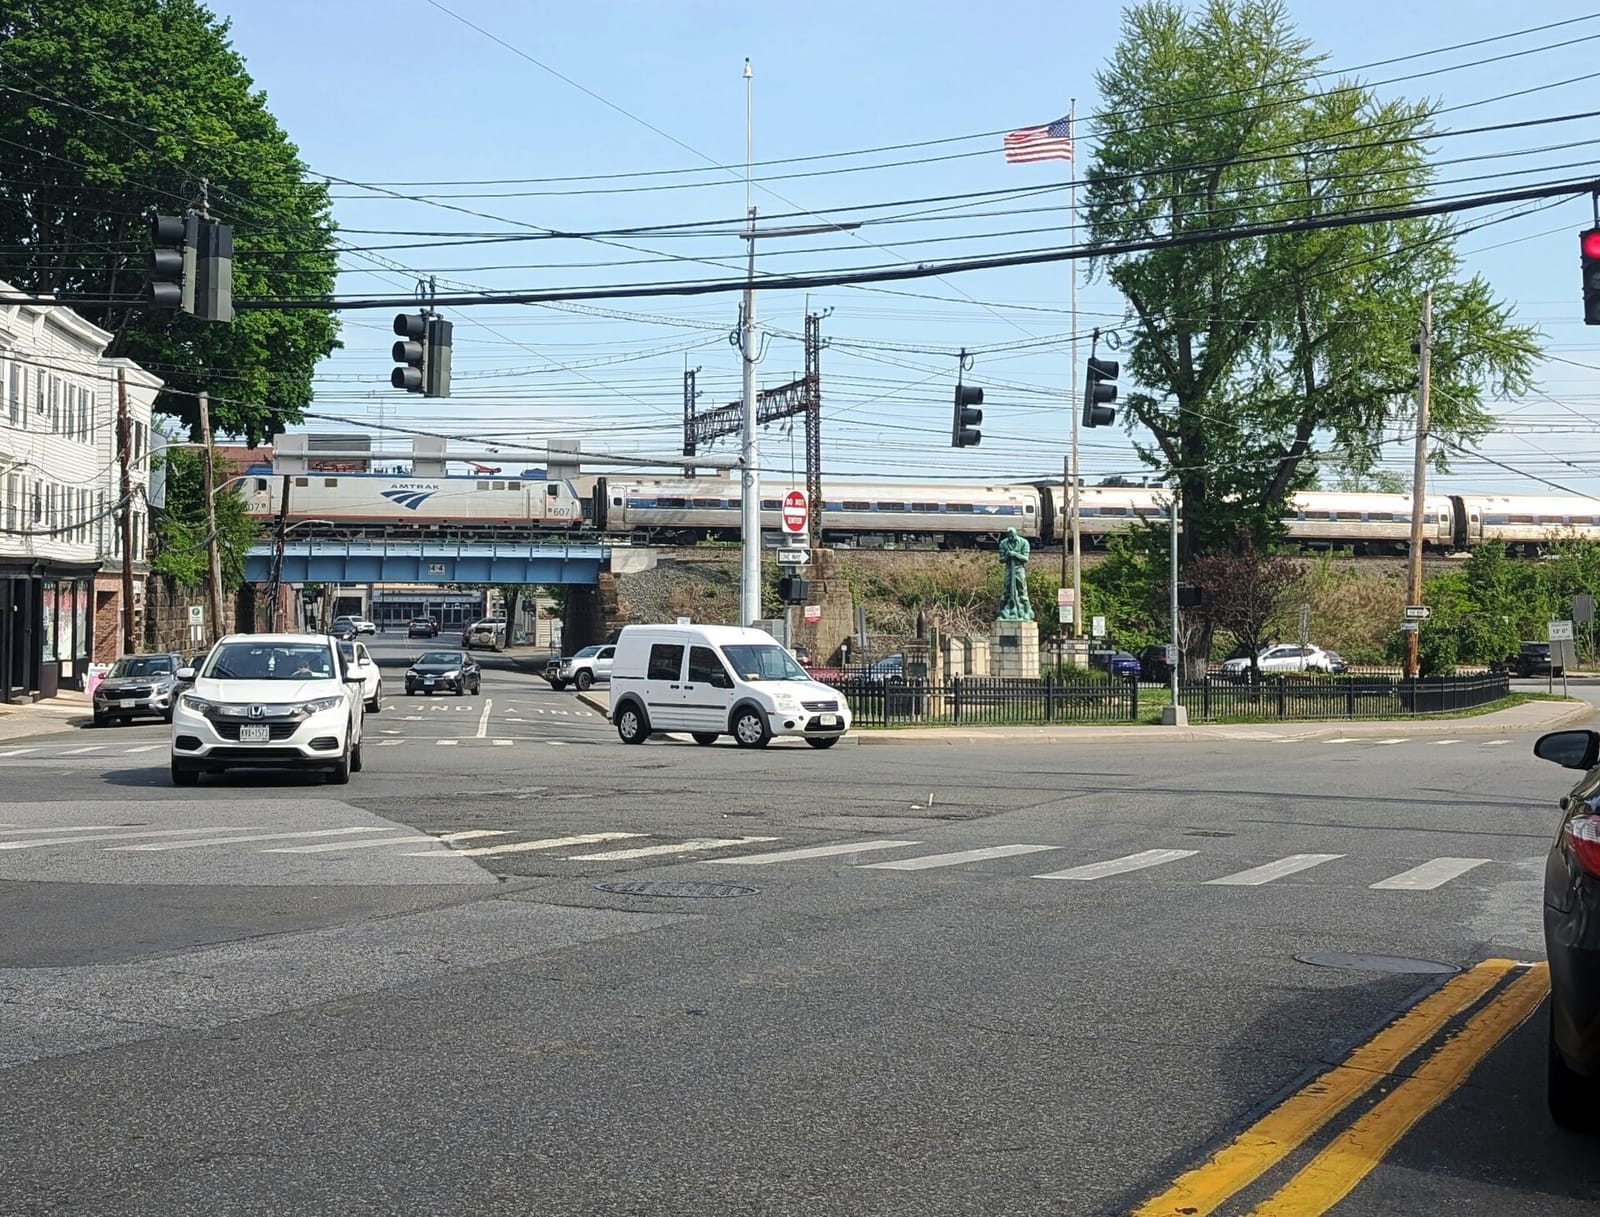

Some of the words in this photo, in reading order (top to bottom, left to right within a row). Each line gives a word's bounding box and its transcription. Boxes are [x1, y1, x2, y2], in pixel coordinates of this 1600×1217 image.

[786, 498, 793, 506] DO
[795, 498, 805, 507] NOT
[553, 507, 570, 517] 607
[788, 516, 803, 525] ENTER
